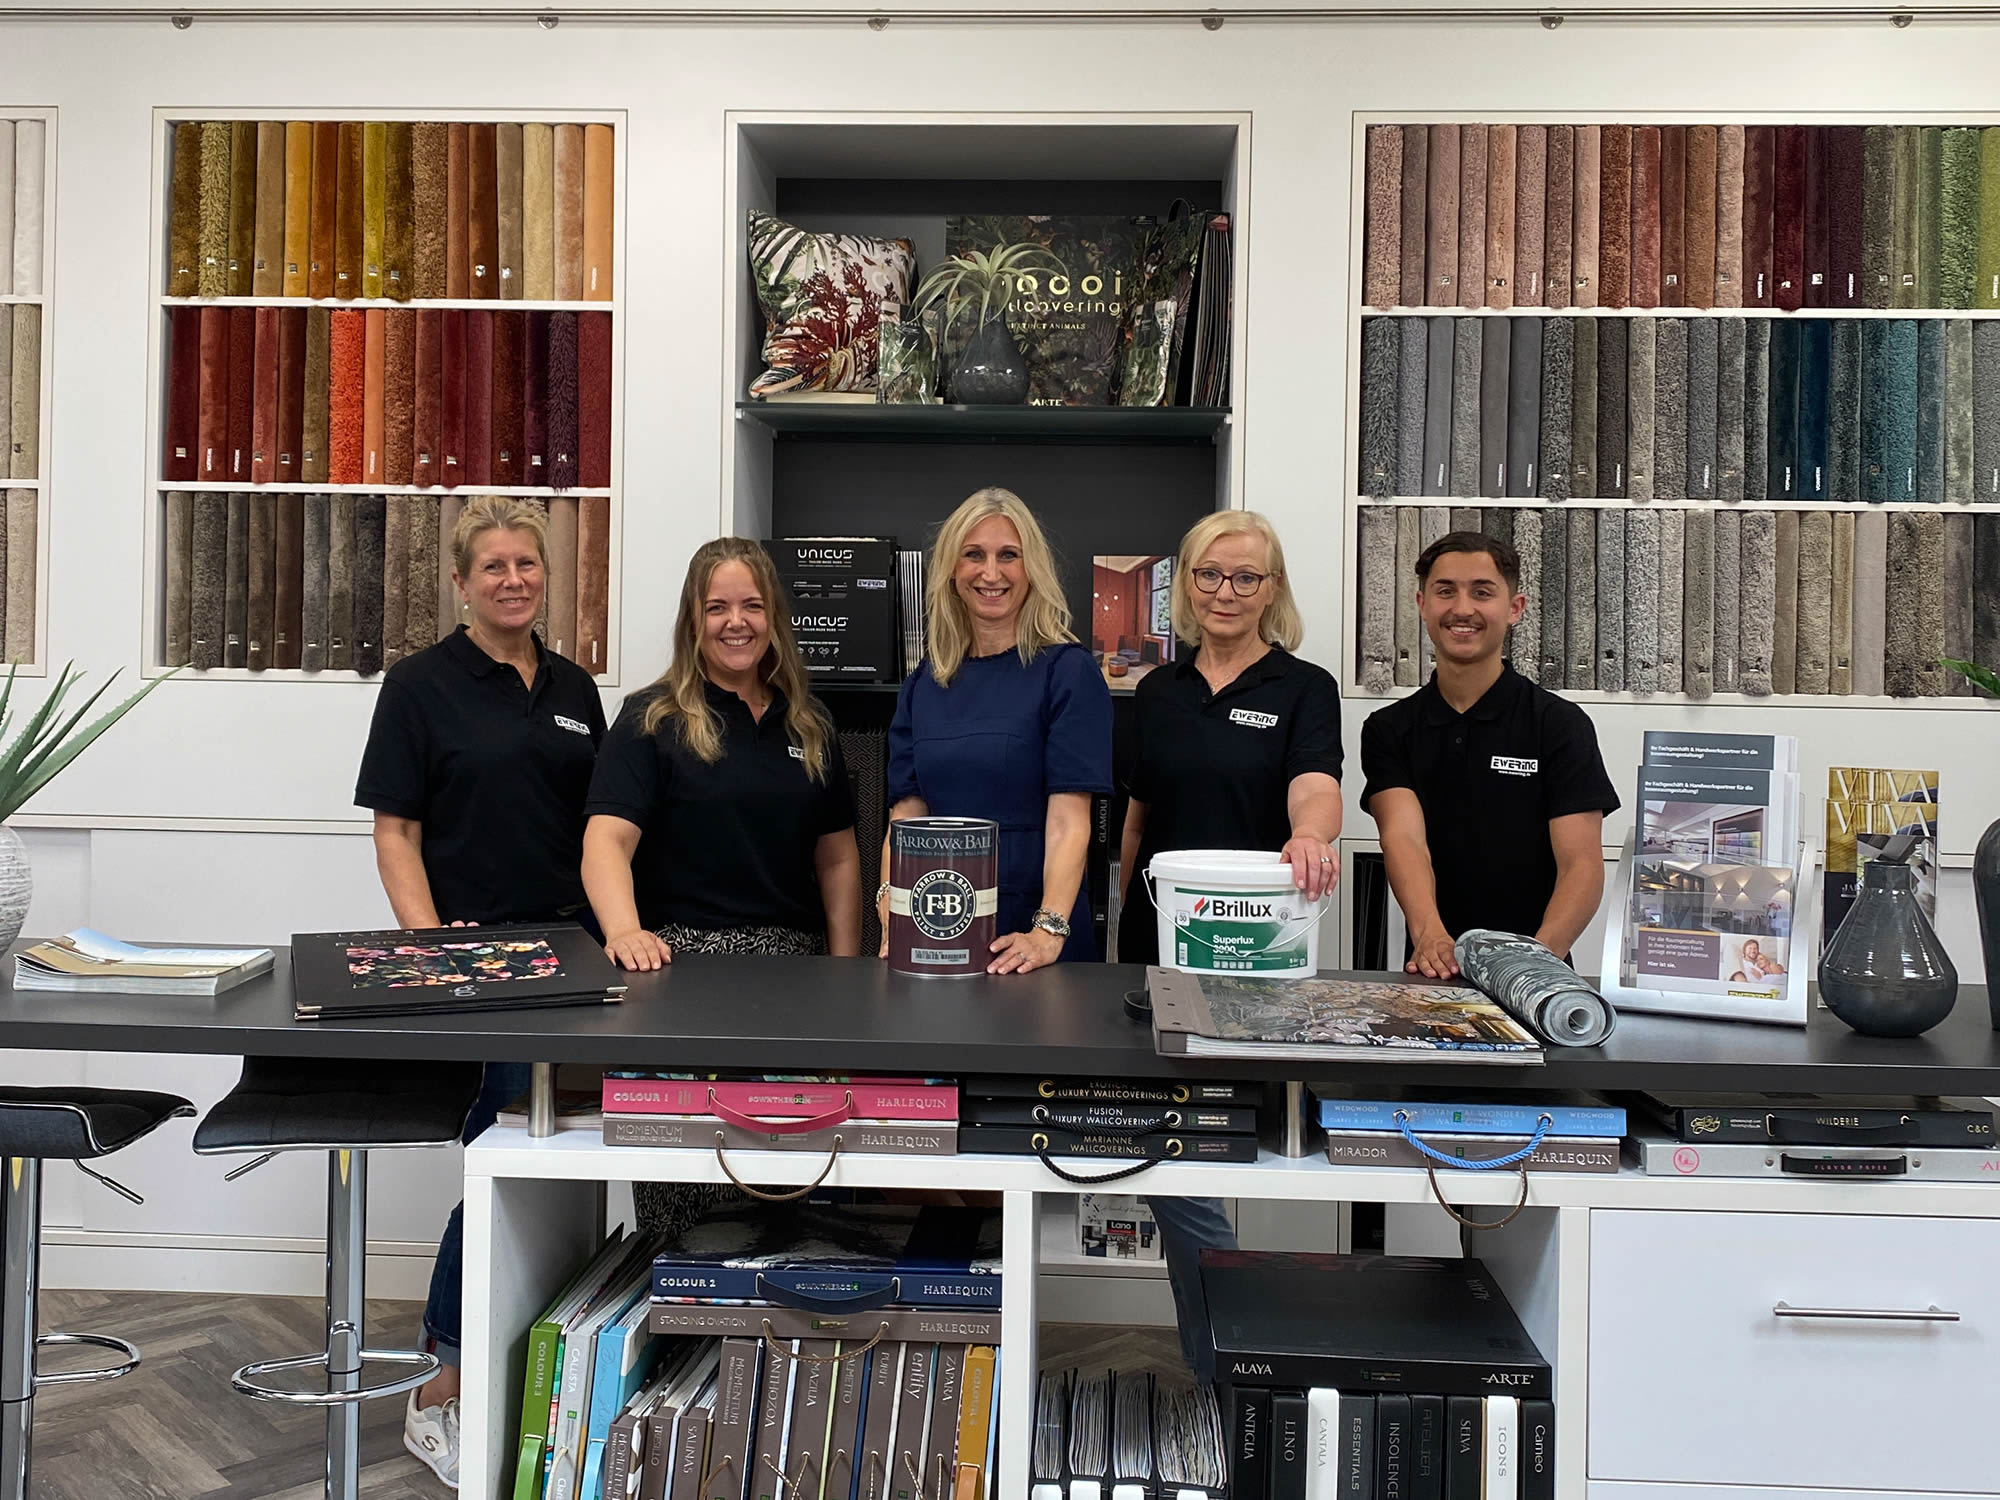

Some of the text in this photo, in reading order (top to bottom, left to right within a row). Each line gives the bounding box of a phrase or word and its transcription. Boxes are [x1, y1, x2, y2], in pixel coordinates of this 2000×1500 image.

[1002, 270, 1121, 295] oooi
[797, 548, 852, 560] UNICUS
[791, 616, 847, 627] UNICUS
[1832, 770, 1931, 803] VIVA
[1829, 802, 1931, 837] VIVA
[913, 872, 973, 900] FARROW & BALL
[925, 894, 962, 916] F&B
[1212, 900, 1272, 918] Brillux
[914, 911, 936, 934] PAINT
[949, 912, 972, 936] PAPER
[1212, 934, 1255, 945] Superlux
[613, 1092, 660, 1102] COLOUR
[876, 1097, 947, 1108] HARLEQUIN
[1093, 1089, 1168, 1100] WALLCOVERINGS
[1089, 1107, 1123, 1116] FUSION
[616, 1124, 683, 1136] MOMENTUM
[1815, 1117, 1860, 1126] WILDERIE
[1967, 1125, 1990, 1134] C&C
[861, 1134, 940, 1147] HARLEQUIN
[1083, 1135, 1133, 1145] MARIANNE
[1070, 1144, 1146, 1155] WALLCOVERINGS
[1334, 1146, 1388, 1158] MIRADOR
[1530, 1151, 1613, 1166] HARLEQUIN
[1111, 1221, 1132, 1230] Lano
[659, 1278, 717, 1287] COLOUR 2
[923, 1284, 993, 1296] HARLEQUIN
[659, 1315, 746, 1327] STANDING OVATION
[919, 1322, 990, 1334] HARLEQUIN
[535, 1341, 546, 1388] COLOUR
[567, 1348, 580, 1393] CALLISTA
[1231, 1362, 1273, 1376] ALAYA
[842, 1353, 856, 1404] ALMETTO
[729, 1357, 745, 1425] MOMENTUM
[764, 1353, 782, 1428] ANTHOZOA
[1243, 1403, 1256, 1460] ANTIGUA
[1459, 1418, 1471, 1454] SELVA
[682, 1425, 697, 1474] SALINAS
[1283, 1421, 1296, 1462] LINO
[1318, 1418, 1328, 1468] CANTALA
[1420, 1409, 1432, 1477] ATELIER
[1534, 1424, 1546, 1473] Cameo
[1351, 1417, 1362, 1491] ESSENTIALS
[1498, 1425, 1507, 1477] ICONS
[1387, 1422, 1400, 1499] INSOLENCE
